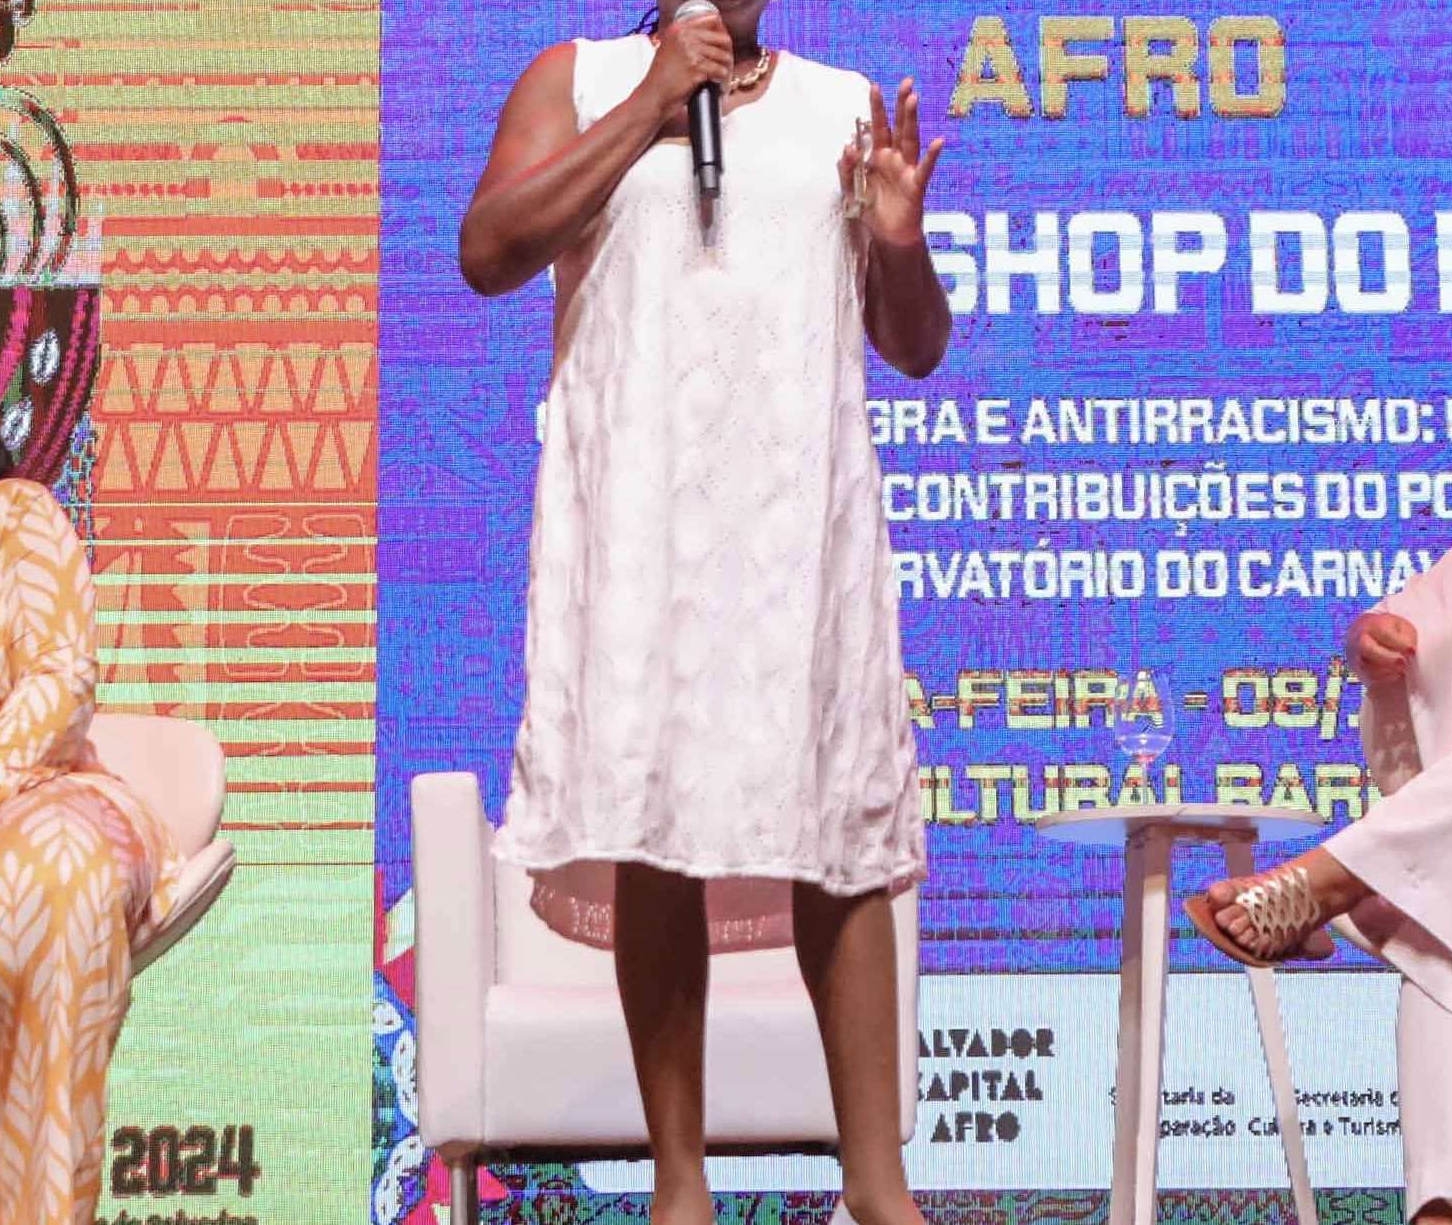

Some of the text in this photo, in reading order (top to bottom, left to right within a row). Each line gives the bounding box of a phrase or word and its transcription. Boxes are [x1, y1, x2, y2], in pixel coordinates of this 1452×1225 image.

[948, 15, 1287, 118] AFRO
[1249, 210, 1411, 314] DO
[976, 399, 1012, 444] E
[1022, 398, 1435, 445] ANTIRRACISMO:
[883, 460, 1307, 536] CONTRIBUIÇÕES
[1316, 473, 1387, 520] DO
[1156, 550, 1229, 598] DO
[1216, 763, 1383, 822] BAR
[917, 1070, 1044, 1102] APITAL
[930, 1111, 1022, 1143] AFRO
[111, 1124, 262, 1199] 2024
